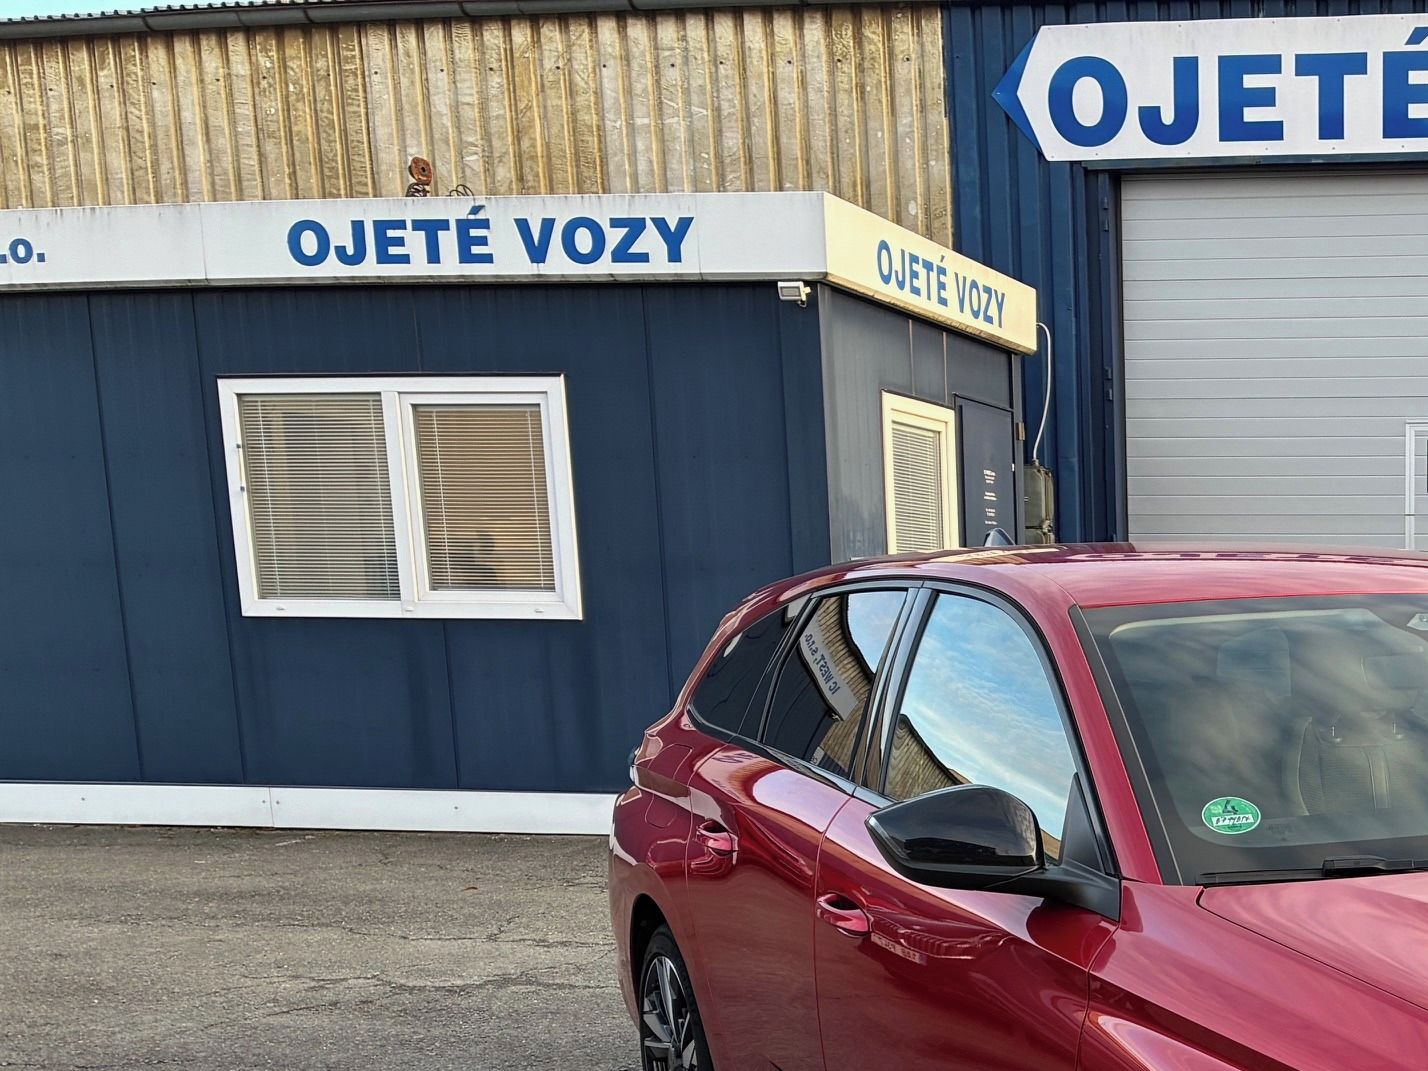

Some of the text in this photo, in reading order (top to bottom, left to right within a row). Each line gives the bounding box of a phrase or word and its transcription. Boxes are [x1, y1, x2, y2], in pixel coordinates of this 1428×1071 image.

[286, 205, 695, 267] OJETÉ VOZY
[876, 239, 1006, 328] OJETÉ VOZY
